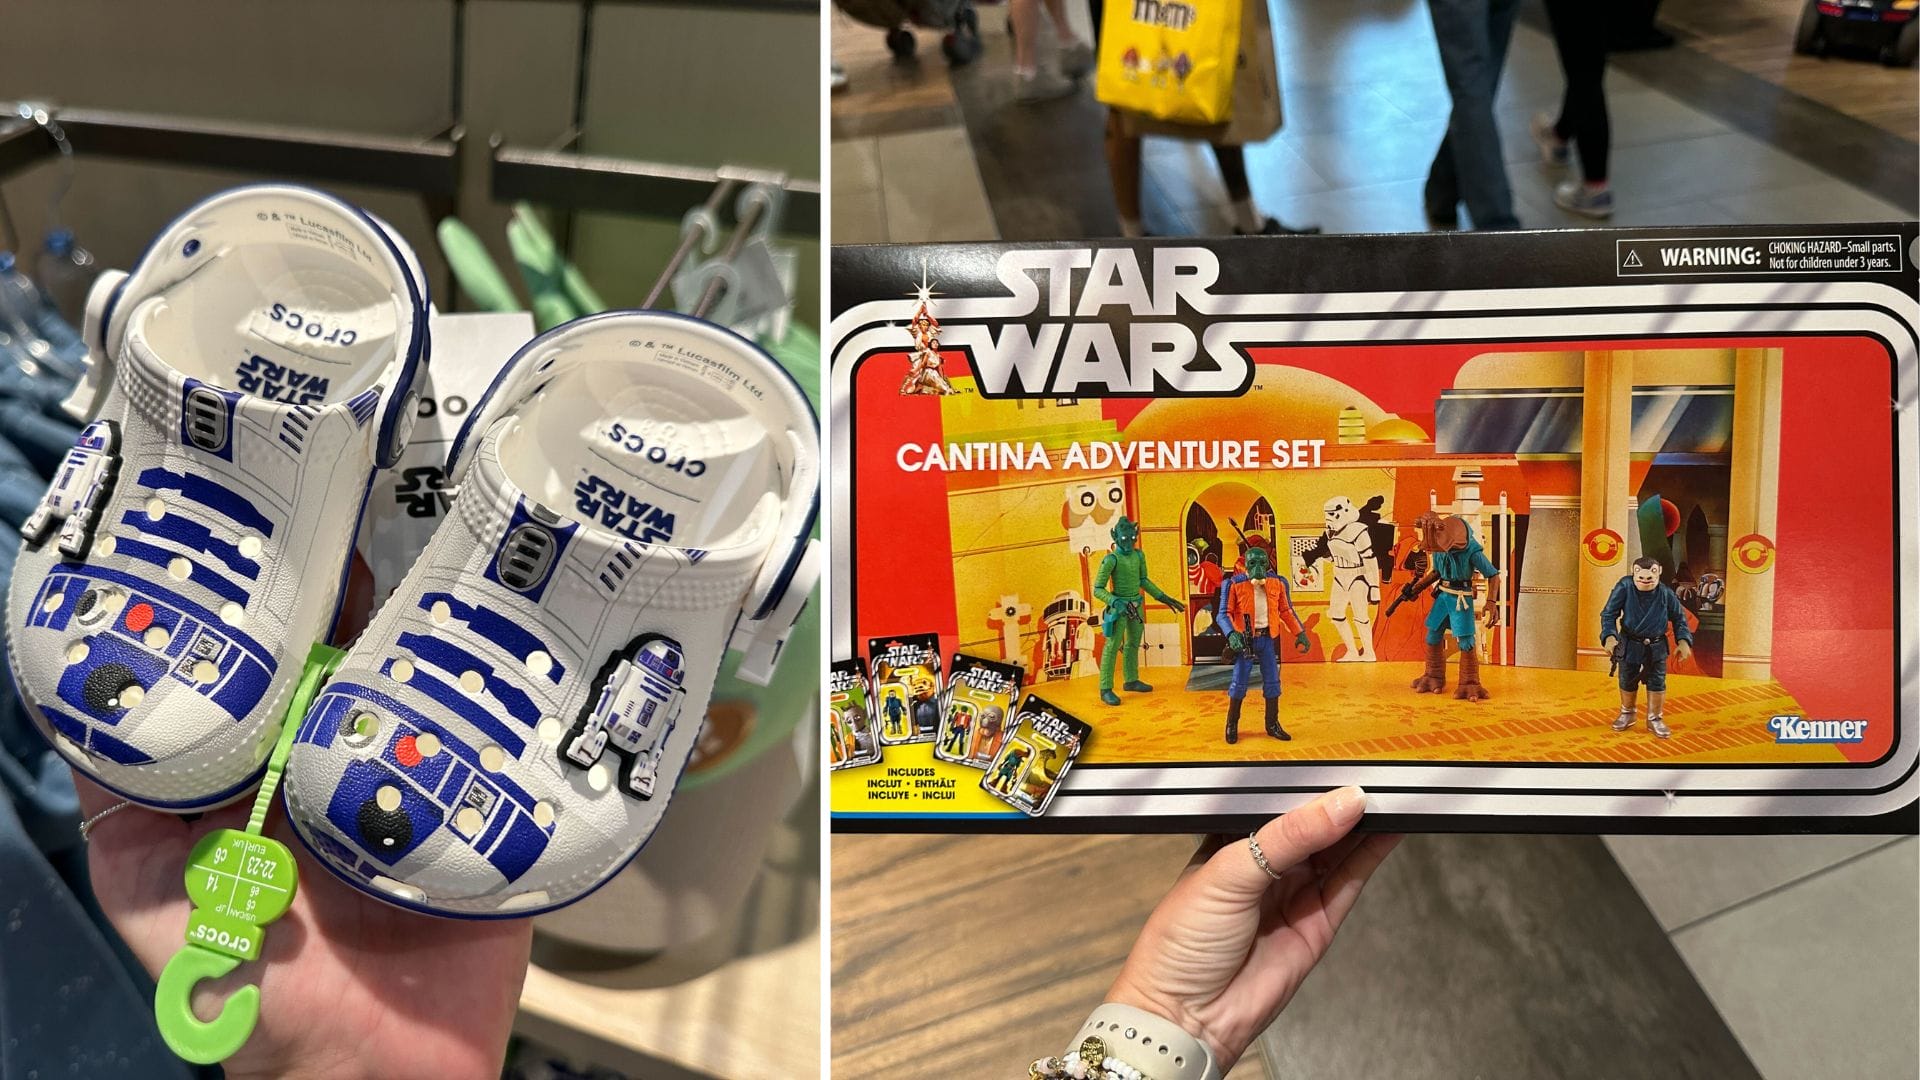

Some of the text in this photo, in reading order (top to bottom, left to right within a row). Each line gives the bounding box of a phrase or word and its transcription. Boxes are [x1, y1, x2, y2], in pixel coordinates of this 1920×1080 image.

[1660, 246, 1761, 267] WARNING:
[1768, 241, 1806, 255] CHOKING
[1871, 242, 1897, 256] parts.
[1769, 255, 1892, 271] Not for children under 3 years.
[996, 247, 1220, 317] STAR
[269, 303, 357, 346] crocs
[971, 322, 1248, 394] WARS
[240, 355, 330, 395] WARS
[678, 347, 740, 381] Lucasfilm
[743, 379, 764, 401] Ltd.
[608, 423, 706, 477] crocs
[896, 439, 1327, 472] CANTINA ADVENTURE SET
[574, 488, 671, 543] STAR
[576, 475, 675, 535] WARS
[1769, 715, 1868, 741] Kenner
[867, 778, 956, 788] INCLUT ENTHÄLT
[888, 768, 936, 777] INCLUDES
[868, 791, 956, 799] INCLUYE INCLUI
[246, 856, 277, 879] 22-23
[206, 873, 219, 893] 14
